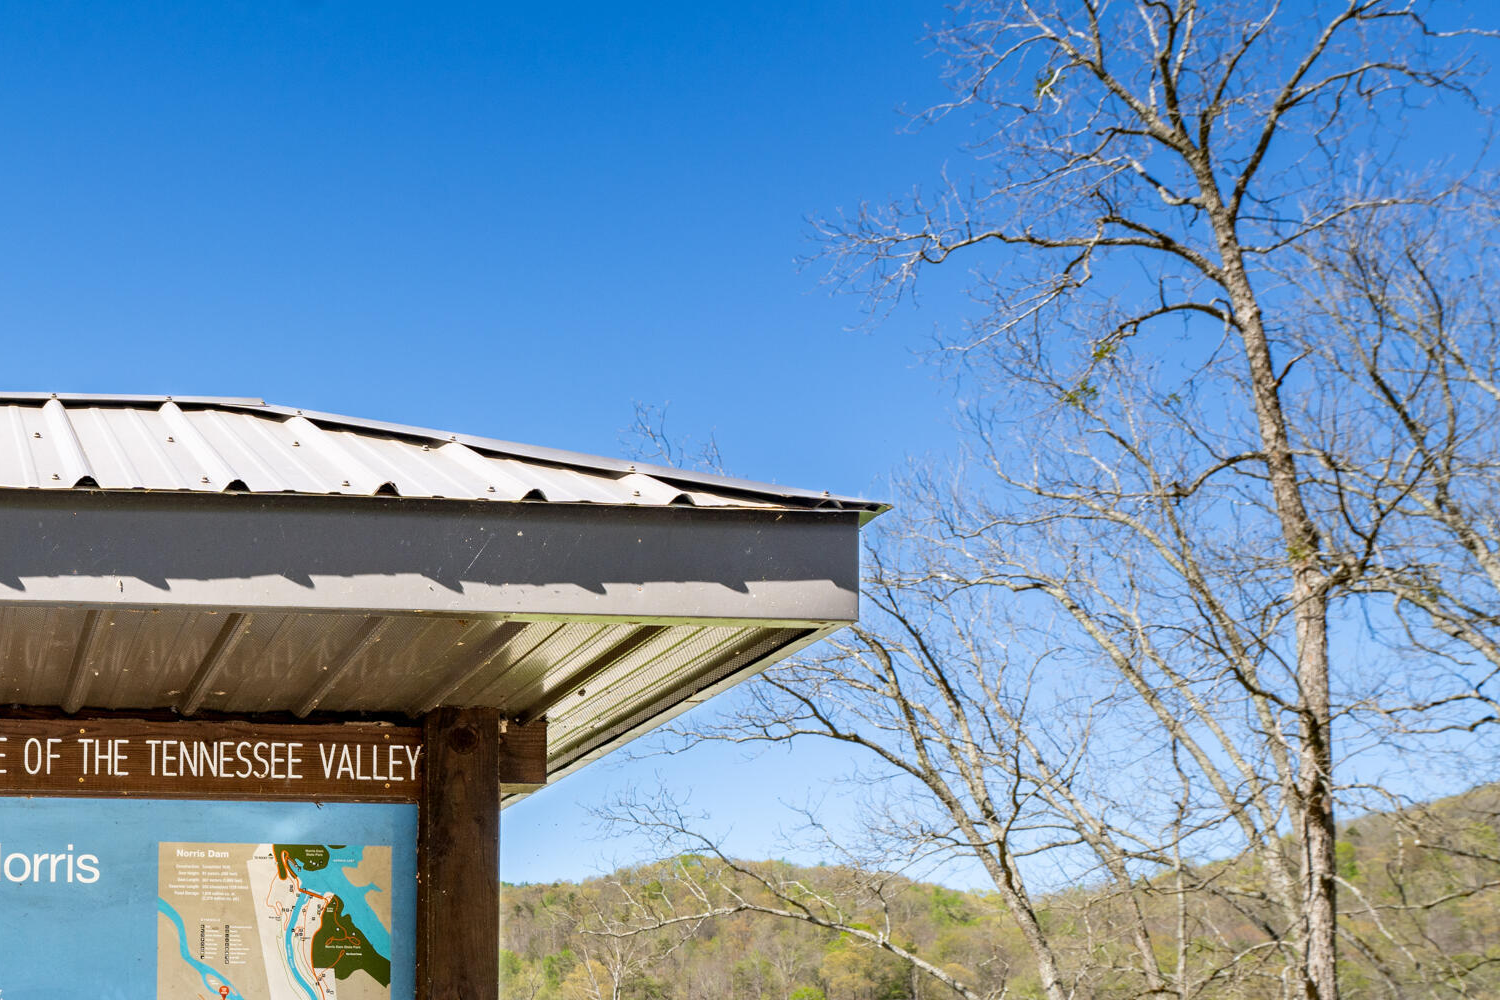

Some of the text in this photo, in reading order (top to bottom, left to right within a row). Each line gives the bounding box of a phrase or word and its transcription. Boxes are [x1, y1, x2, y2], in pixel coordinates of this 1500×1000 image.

[24, 737, 62, 775] OF
[77, 738, 130, 777] THE
[145, 739, 304, 779] TENNESSEE
[318, 743, 421, 781] VALLEY
[176, 849, 229, 858] Norris Dam
